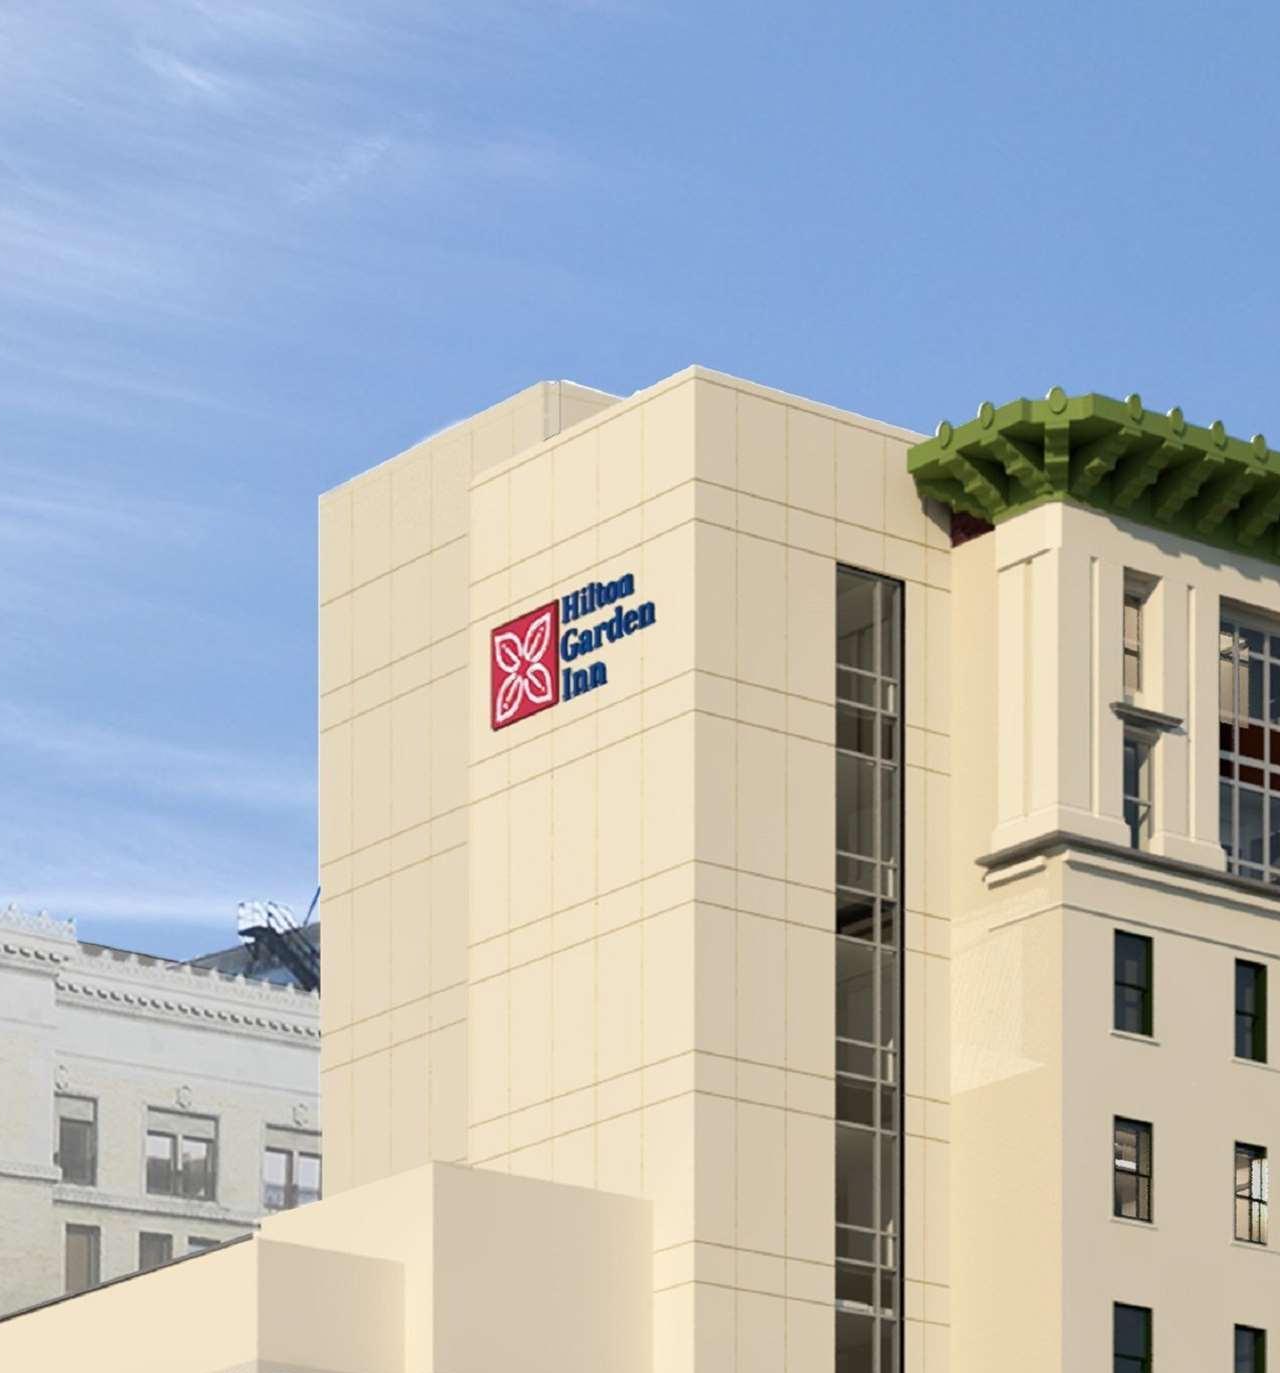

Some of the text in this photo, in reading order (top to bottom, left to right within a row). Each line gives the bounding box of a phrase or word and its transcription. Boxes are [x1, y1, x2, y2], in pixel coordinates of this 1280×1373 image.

[562, 573, 635, 625] Hilton
[560, 601, 656, 663] Garden
[562, 661, 608, 702] Inn
